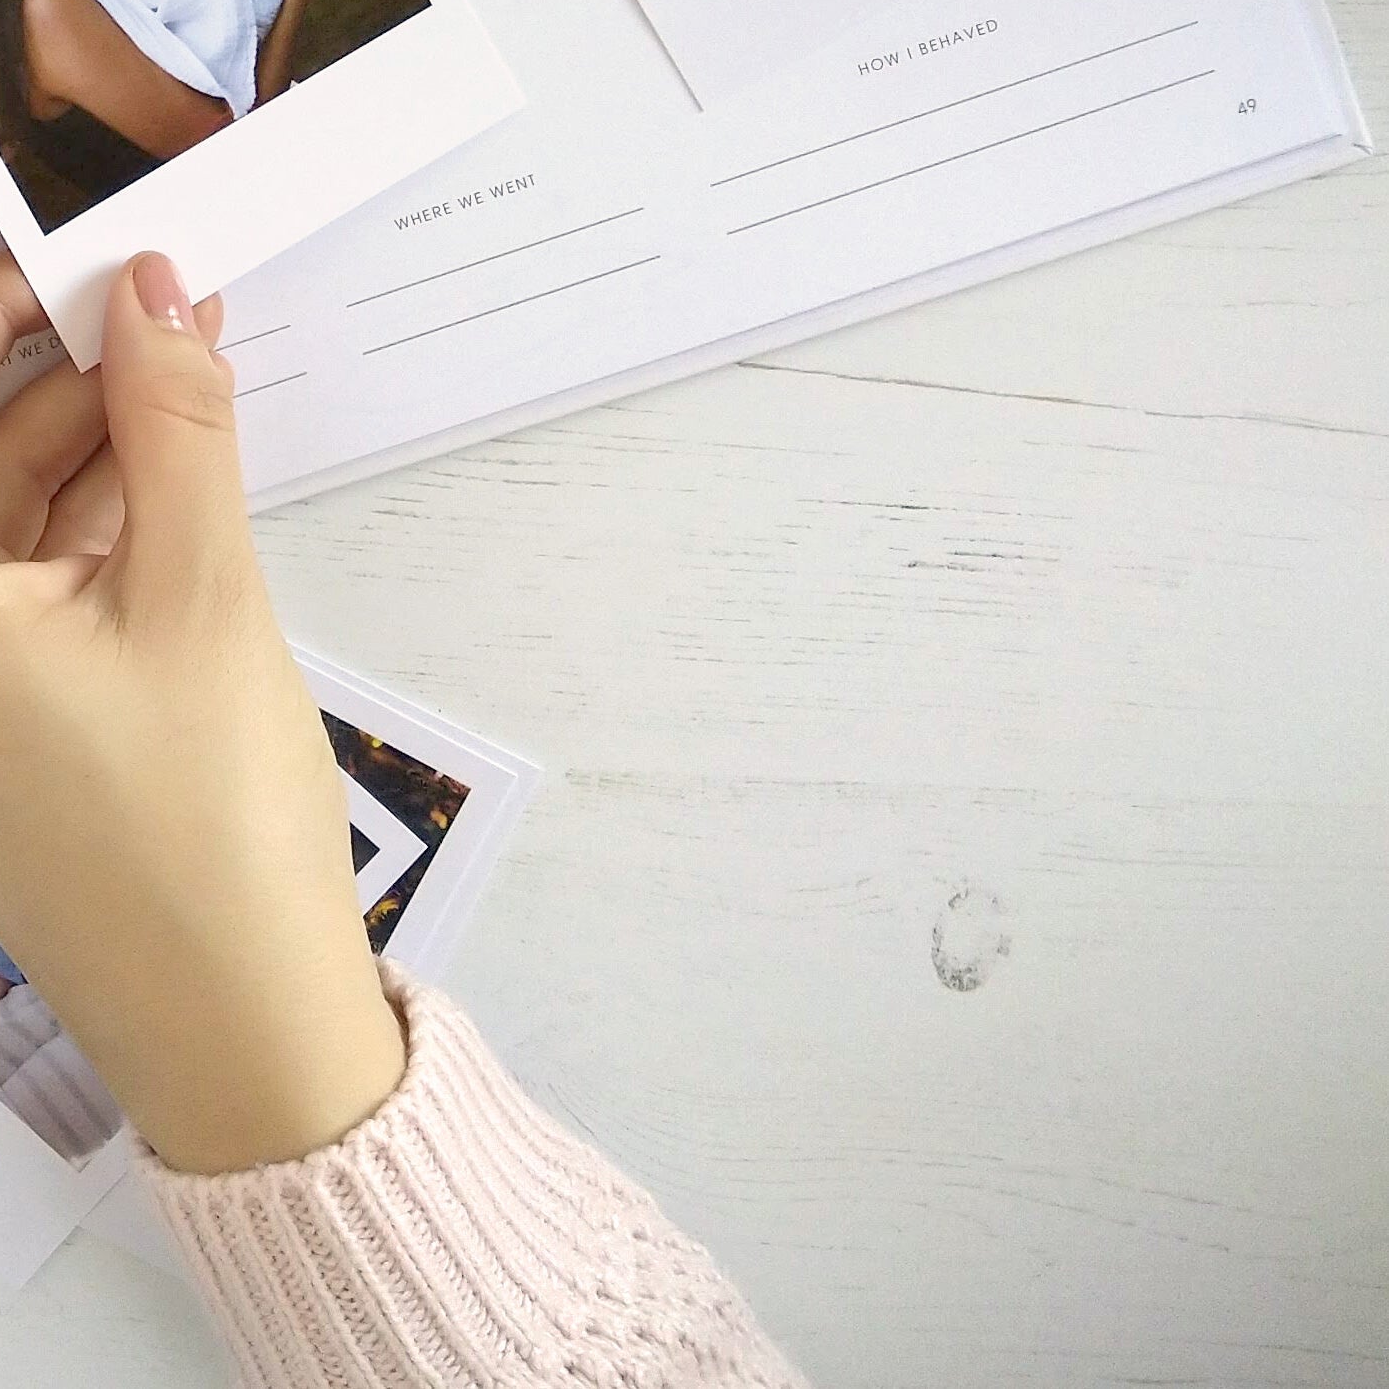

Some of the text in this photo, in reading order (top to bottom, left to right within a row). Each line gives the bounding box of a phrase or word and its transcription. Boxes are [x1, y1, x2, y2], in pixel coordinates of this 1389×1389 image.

[857, 19, 999, 76] HOW I BEHAVED
[1237, 98, 1257, 116] 49
[393, 173, 537, 231] WHERE WE WENT
[17, 341, 43, 360] WE
